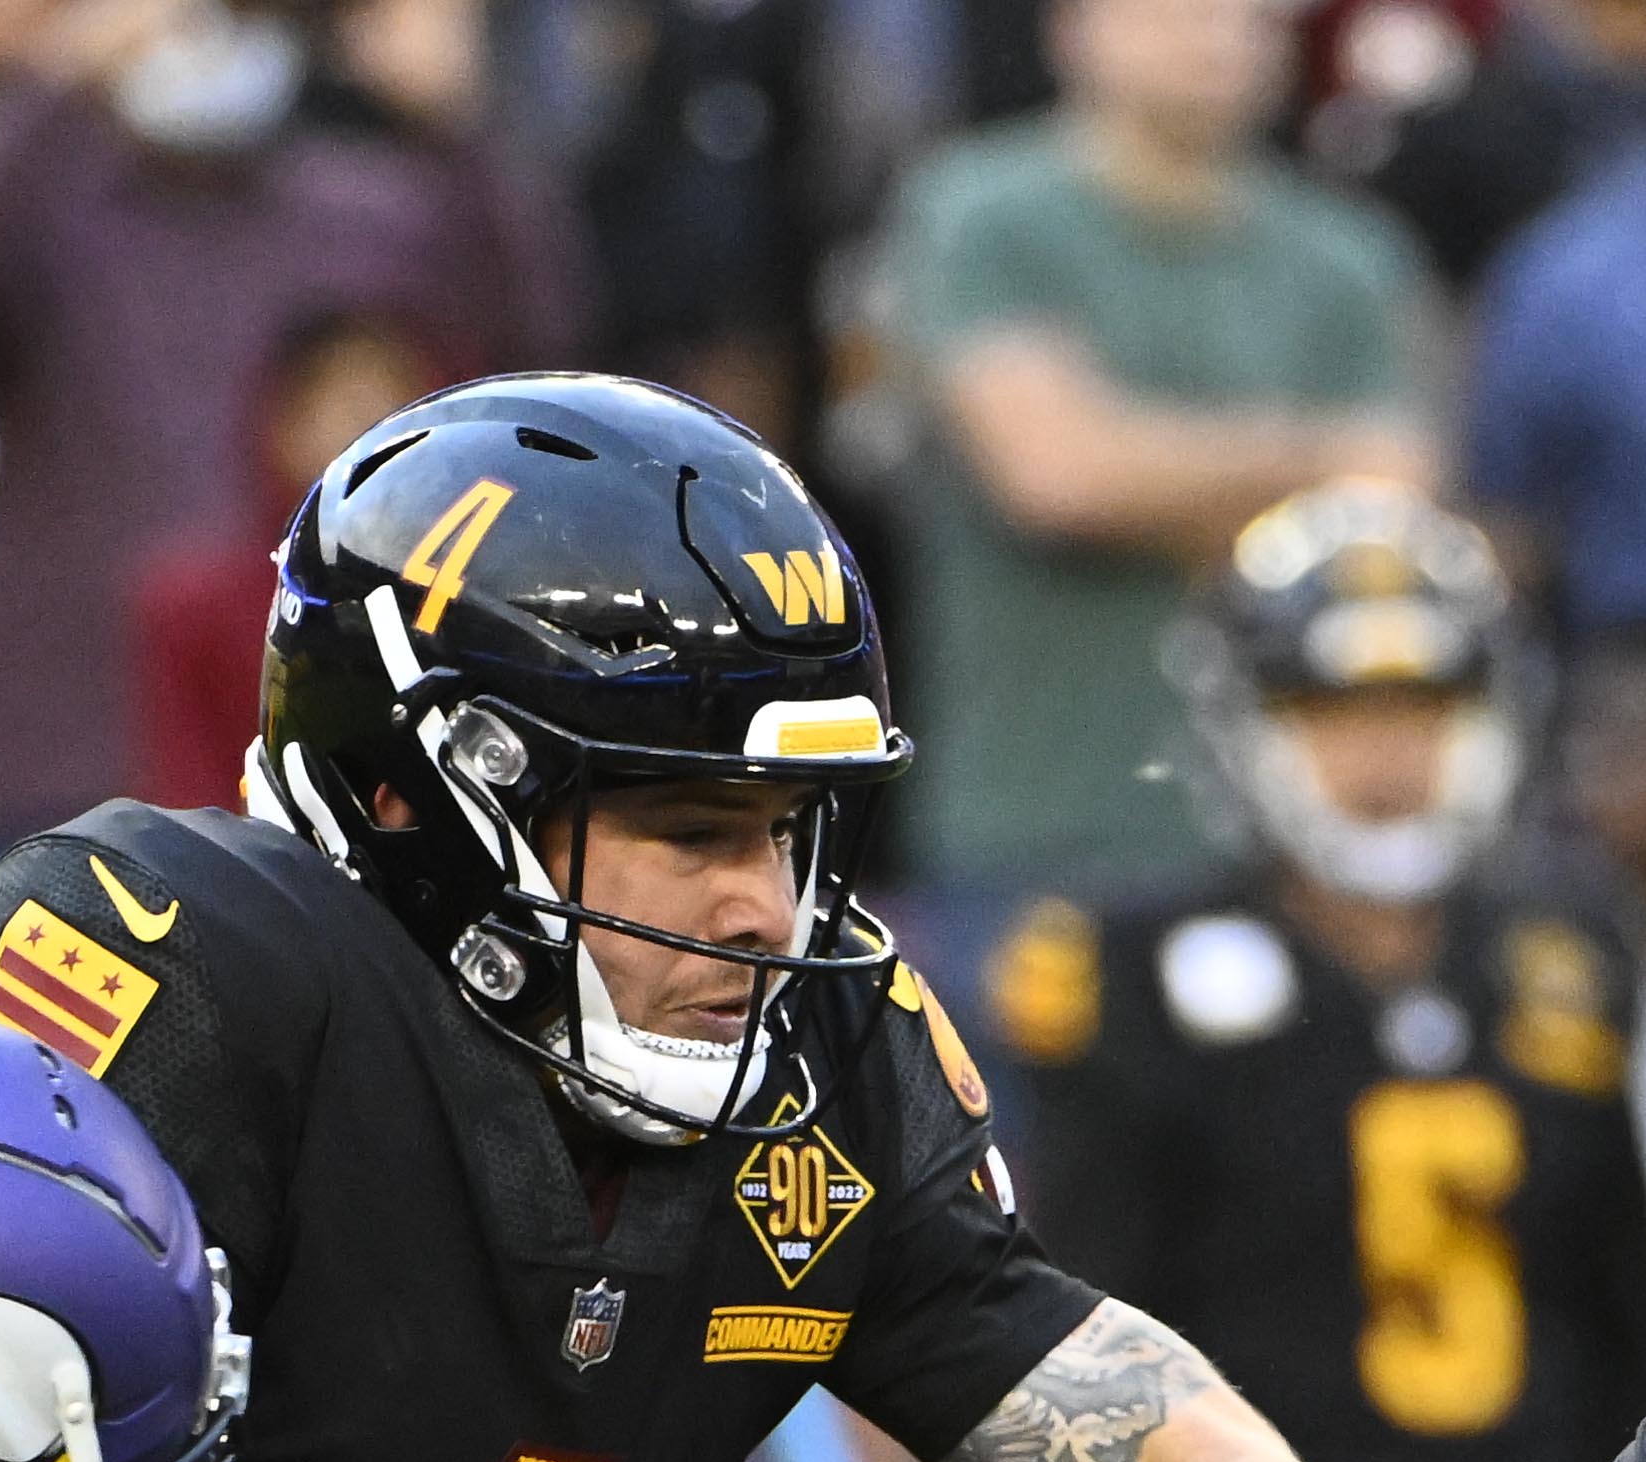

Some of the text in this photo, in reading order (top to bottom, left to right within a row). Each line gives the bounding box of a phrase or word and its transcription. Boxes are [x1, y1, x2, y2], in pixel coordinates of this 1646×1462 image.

[402, 480, 514, 635] 4
[740, 550, 846, 626] W
[768, 1144, 827, 1237] 90
[828, 1184, 864, 1200] 2022
[777, 1241, 811, 1260] YEARS
[1350, 1080, 1527, 1437] 5
